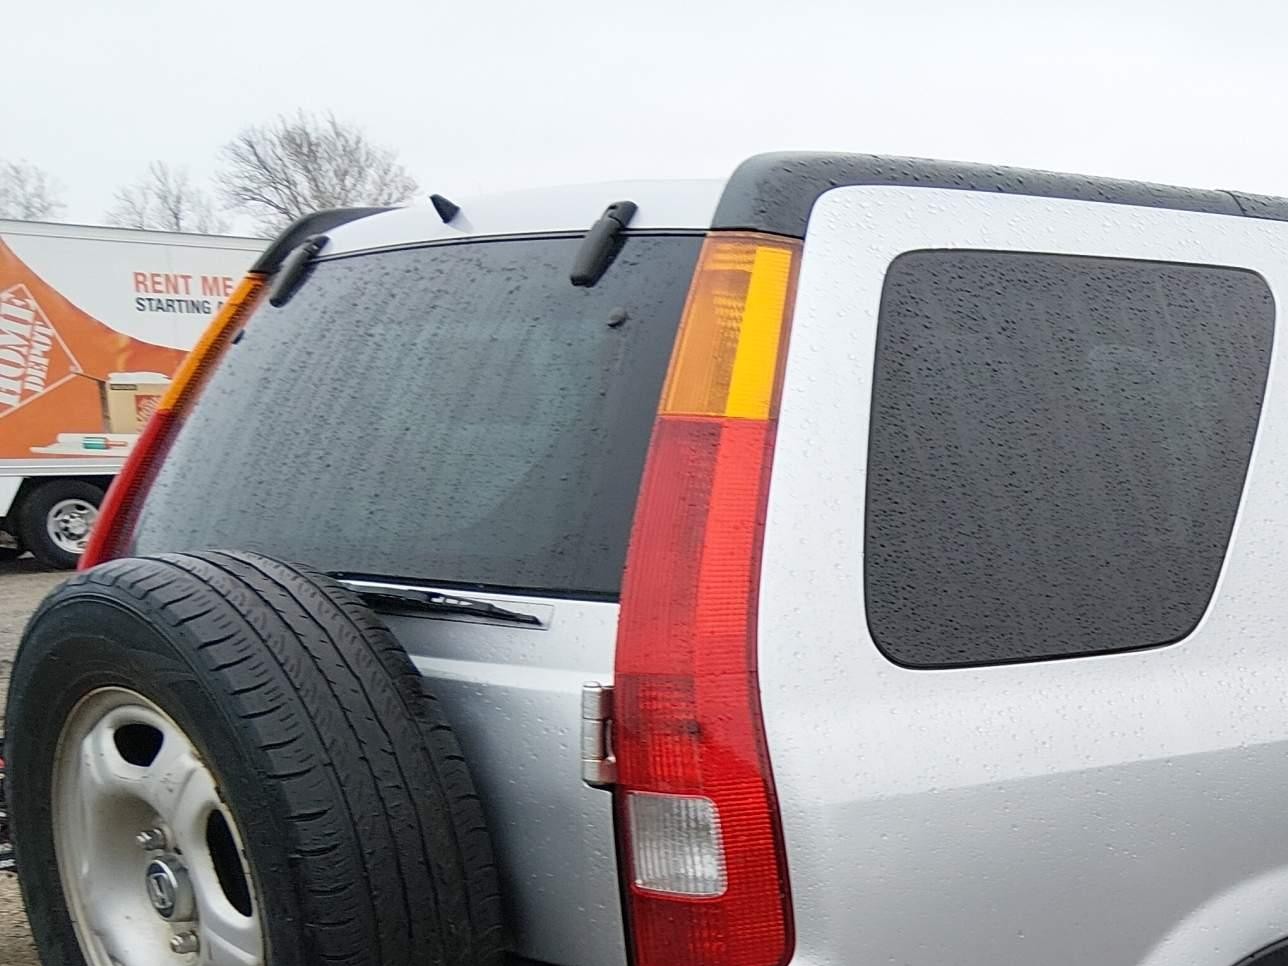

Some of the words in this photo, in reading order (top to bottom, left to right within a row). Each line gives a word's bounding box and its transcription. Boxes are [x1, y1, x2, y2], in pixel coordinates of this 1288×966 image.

[132, 271, 193, 295] RENT
[201, 275, 233, 297] ME
[136, 297, 211, 314] STARTING
